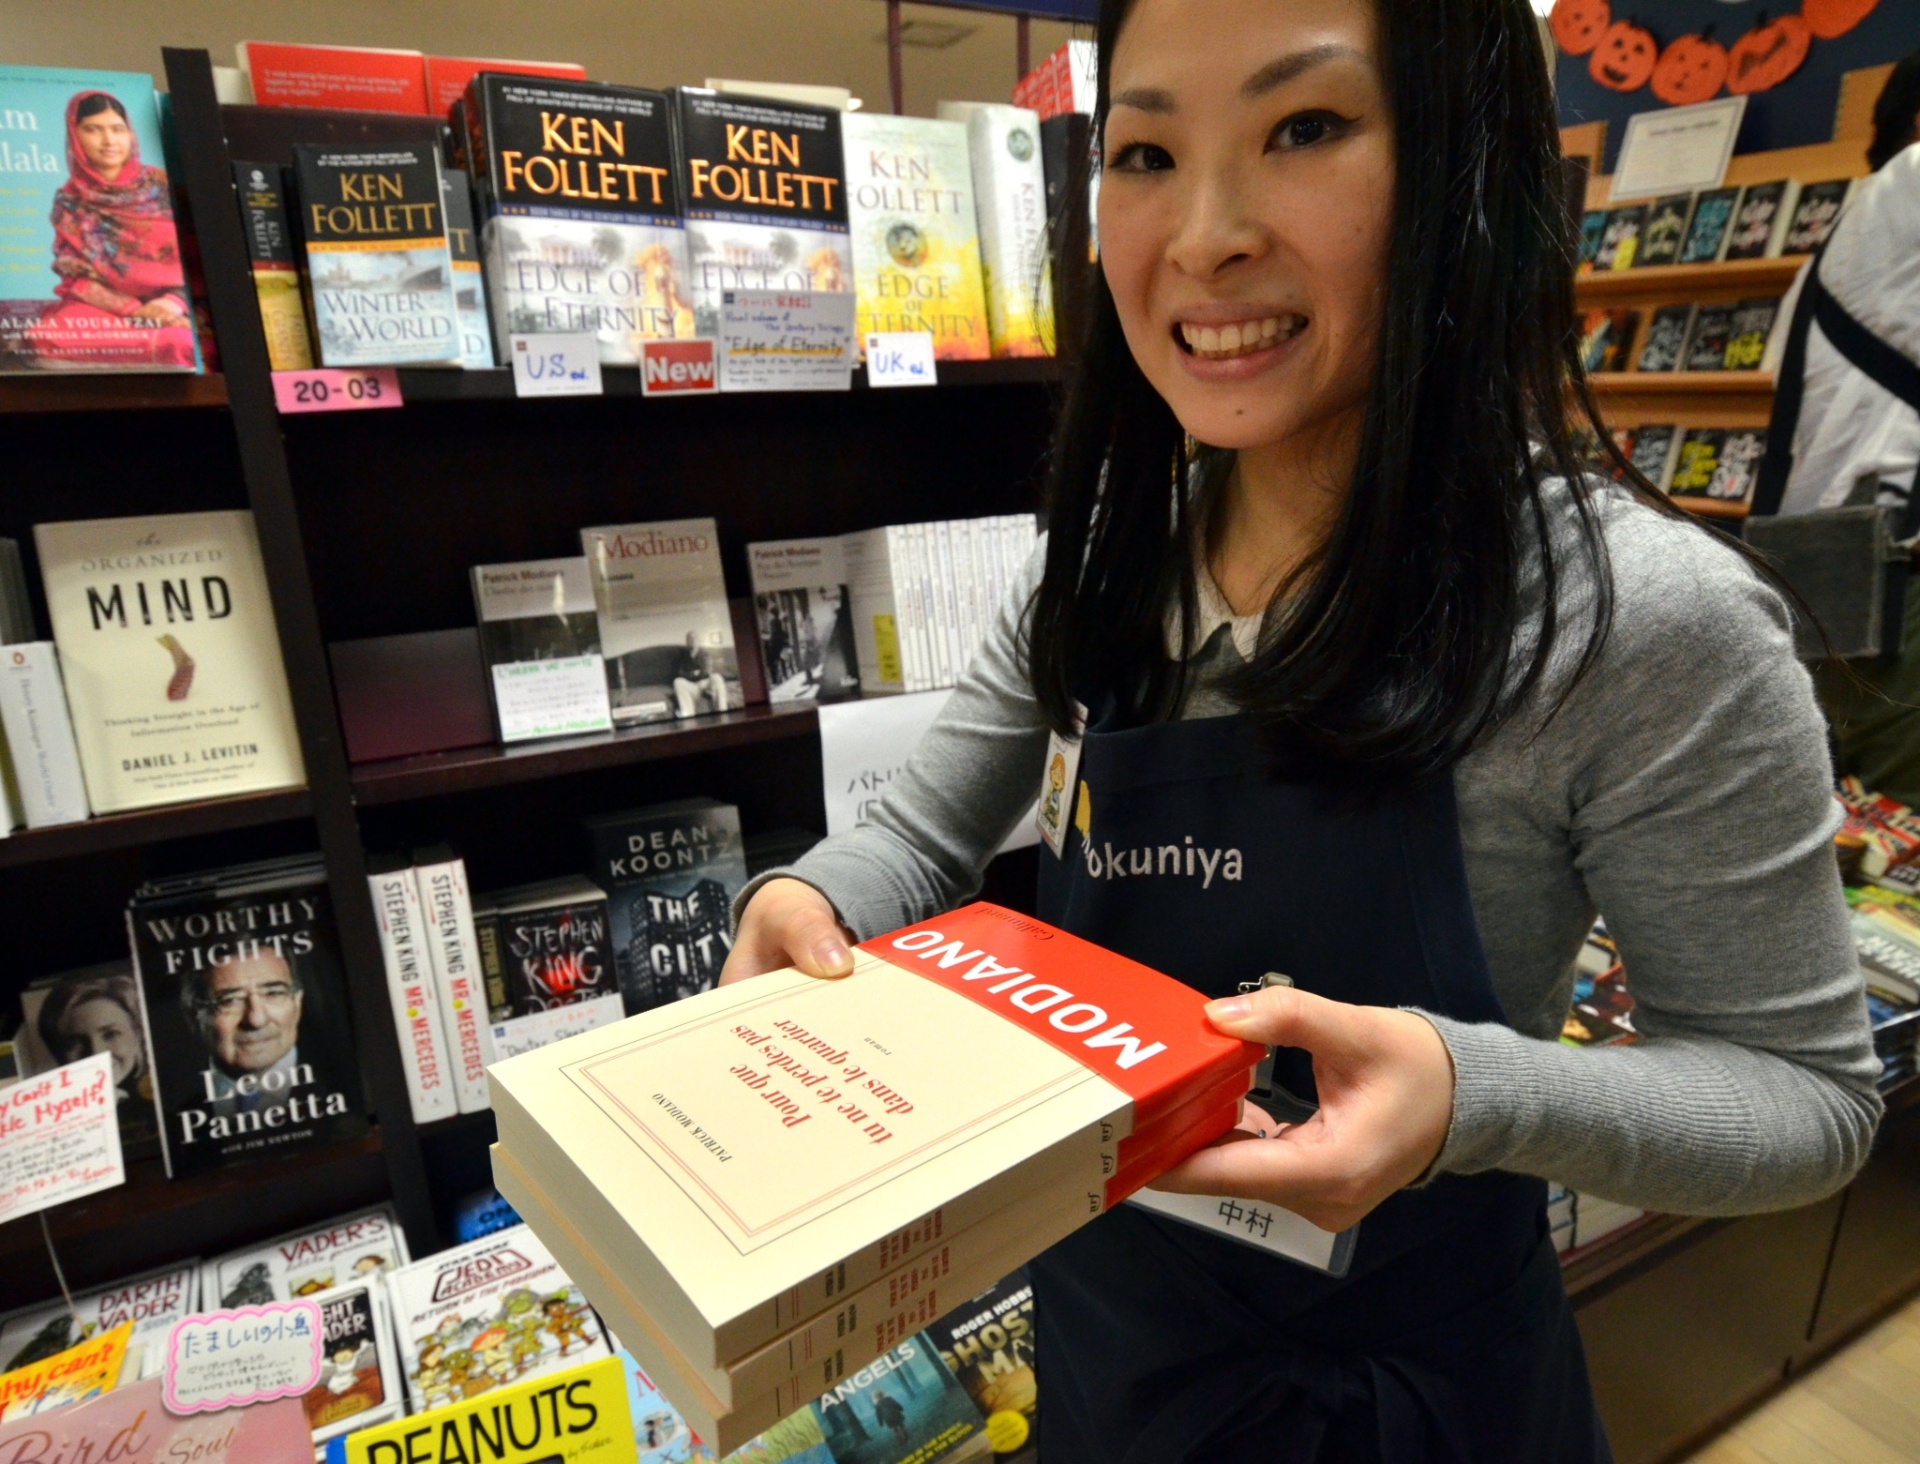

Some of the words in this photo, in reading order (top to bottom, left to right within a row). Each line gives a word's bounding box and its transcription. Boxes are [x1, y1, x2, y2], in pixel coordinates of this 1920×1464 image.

[0, 108, 38, 130] m
[540, 111, 625, 157] KEN
[0, 140, 60, 173] lala
[725, 123, 799, 168] KEN
[502, 150, 668, 204] FOLLETT
[869, 151, 930, 180] KEN
[340, 172, 403, 202] KEN
[689, 159, 839, 211] FOLLETT
[311, 203, 436, 234] FOLLETT
[517, 260, 598, 295] EDGE
[608, 269, 646, 297] OF
[878, 274, 949, 299] EDGE
[323, 289, 426, 316] WINTER
[545, 296, 677, 338] ETERNITY
[65, 315, 162, 330] YOUSAFZAI
[349, 315, 453, 343] WORLD
[526, 353, 566, 380] US
[646, 356, 714, 384] New
[874, 351, 905, 376] UK
[293, 377, 382, 403] 20-03
[81, 550, 223, 573] ORGANIZED
[596, 530, 709, 560] Modiano
[86, 575, 233, 631] MIND
[122, 753, 176, 771] DANIEL
[183, 751, 197, 764] J.
[202, 743, 259, 762] LEVITIN
[628, 826, 708, 854] DEAN
[609, 841, 728, 877] KOONTZ
[147, 897, 319, 944] WORTHY
[384, 882, 411, 944] STEPHEN
[432, 874, 458, 938] STEPHEN
[647, 890, 700, 924] THE
[164, 930, 315, 976] FIGHTS
[508, 915, 604, 958] STEPHEN
[398, 948, 419, 982] KING
[444, 942, 466, 974] KING
[523, 945, 603, 996] KING
[892, 930, 1168, 1070] MODIANO
[411, 1019, 440, 1091] MERCEDES
[457, 1009, 484, 1082] MERCEDES
[730, 1023, 774, 1050] pas
[773, 1017, 850, 1067] quartier
[863, 1036, 894, 1057] roman
[199, 1063, 316, 1104] Leon
[729, 1063, 772, 1090] que
[758, 1043, 830, 1088] perdes
[842, 1063, 868, 1084] le
[34, 1069, 107, 1124] Myself?
[651, 1091, 693, 1128] MODIANO
[760, 1090, 814, 1129] Pour
[815, 1086, 843, 1105] te
[836, 1101, 870, 1124] ne
[862, 1078, 914, 1116] dans
[176, 1089, 348, 1145] Panetta
[862, 1121, 893, 1145] tu
[690, 1127, 733, 1164] PATRICK
[1217, 1199, 1275, 1239] 中村
[441, 1260, 522, 1297] ACADEMY
[445, 1253, 505, 1285] JEDI
[100, 1271, 183, 1314] DARTH
[98, 1292, 180, 1331] VADER
[951, 1309, 995, 1340] ROGER
[0, 1371, 42, 1402] hy
[819, 1341, 916, 1414] ANGELS
[0, 1409, 152, 1464] Bird
[366, 1379, 598, 1464] PEANUTS
[168, 1426, 236, 1464] Soul
